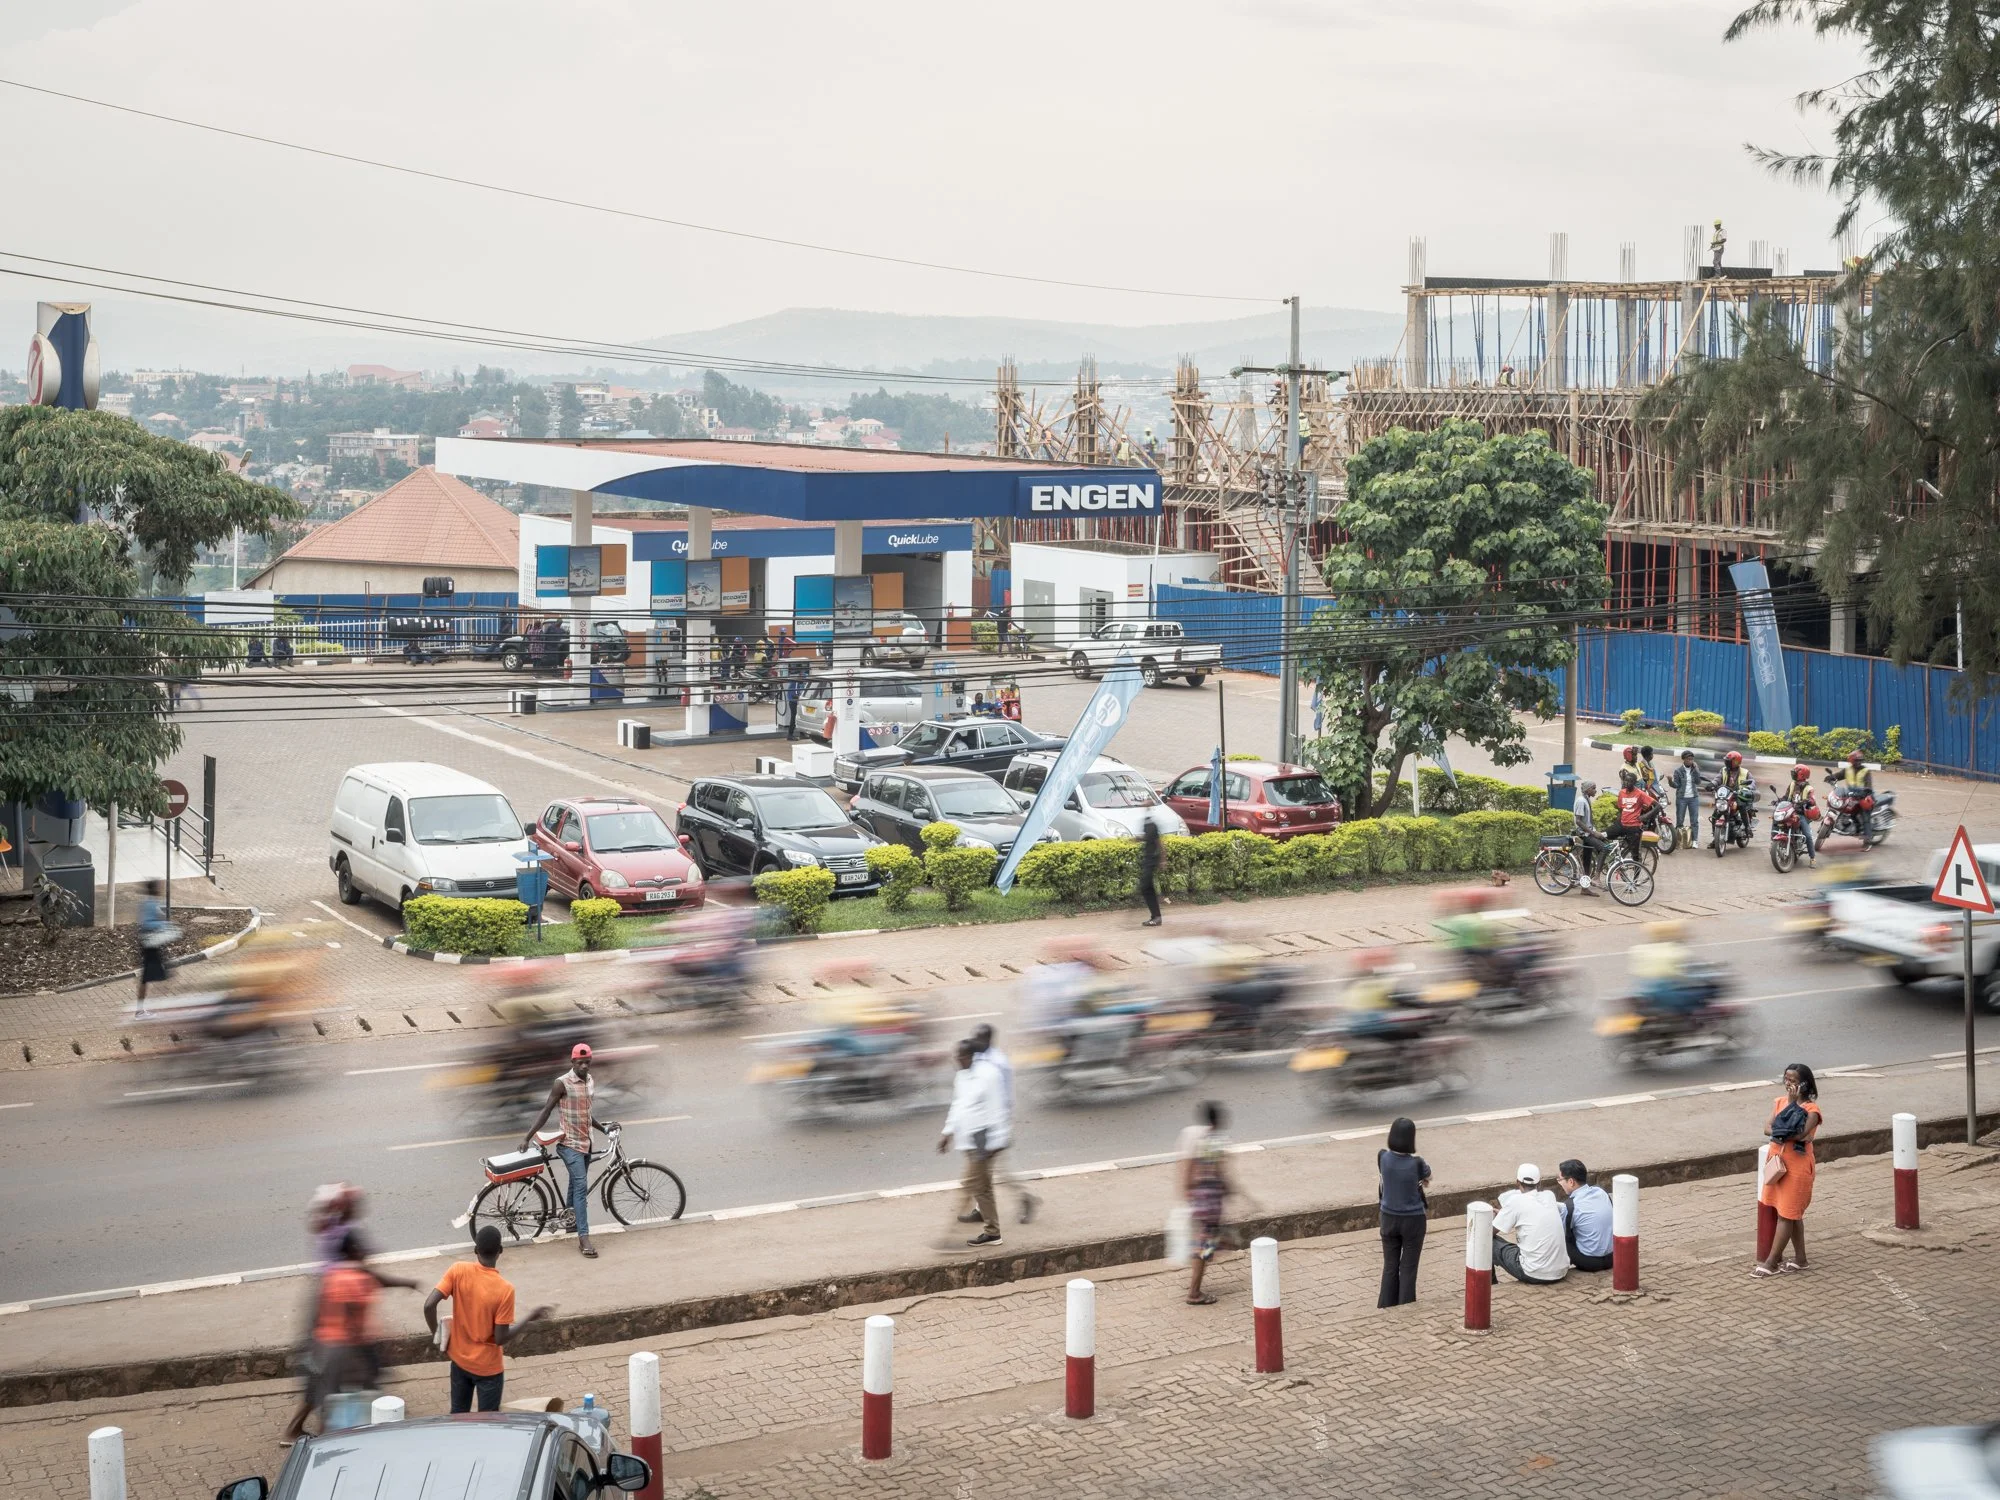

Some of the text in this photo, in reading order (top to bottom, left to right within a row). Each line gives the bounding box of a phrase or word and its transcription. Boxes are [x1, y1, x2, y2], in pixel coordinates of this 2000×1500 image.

[1031, 484, 1155, 511] ENGEN
[671, 539, 728, 554] Quube
[887, 533, 940, 548] QuickLube
